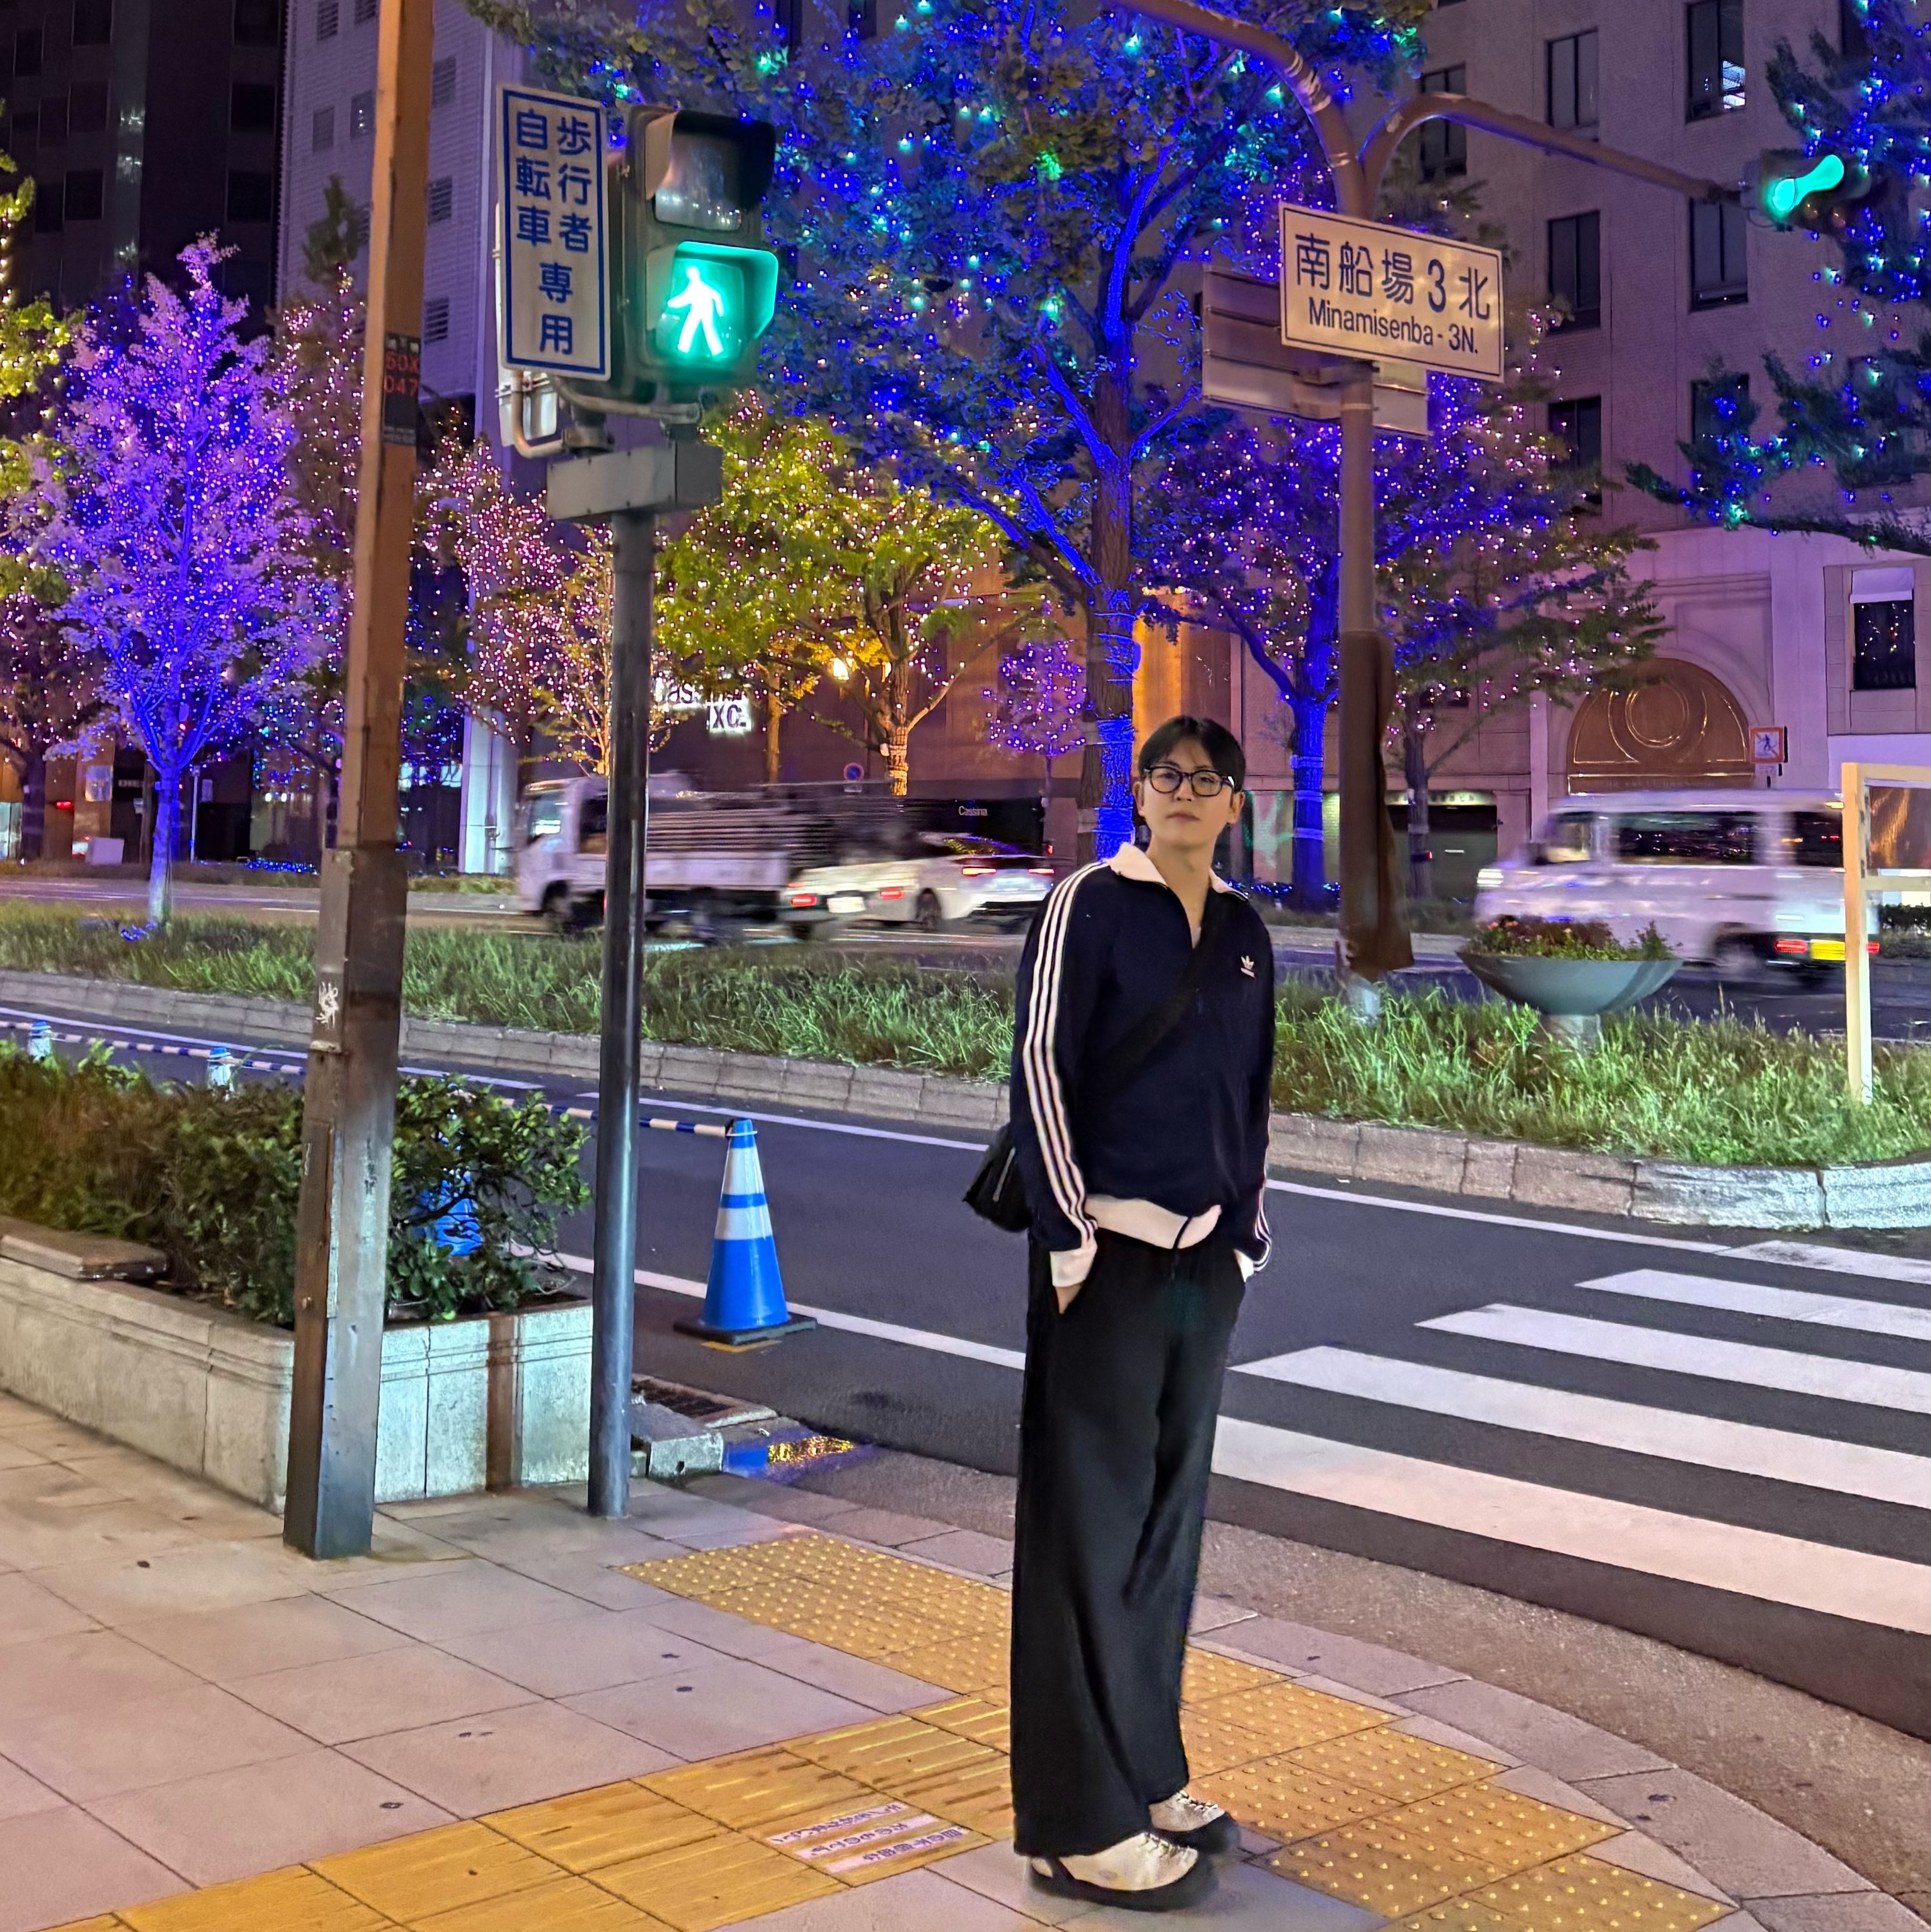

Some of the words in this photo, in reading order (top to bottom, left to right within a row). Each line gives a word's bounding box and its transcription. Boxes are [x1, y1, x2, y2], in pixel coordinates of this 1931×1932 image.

[515, 108, 552, 247] 自転車
[557, 115, 593, 254] 歩行者
[538, 261, 573, 355] 専用
[383, 374, 418, 397] 047
